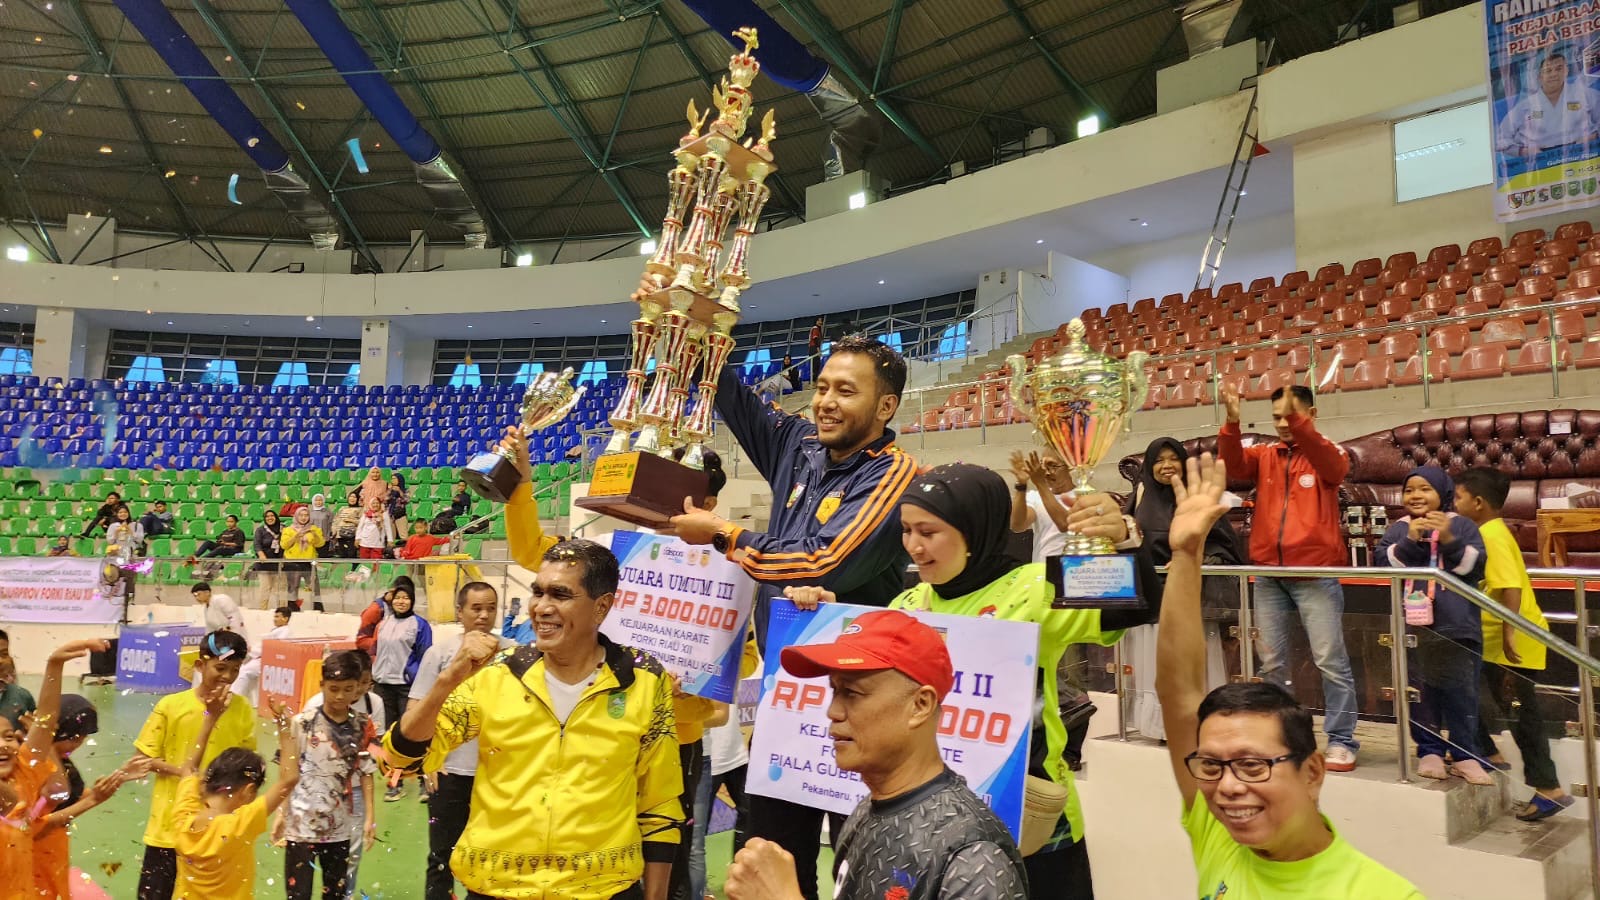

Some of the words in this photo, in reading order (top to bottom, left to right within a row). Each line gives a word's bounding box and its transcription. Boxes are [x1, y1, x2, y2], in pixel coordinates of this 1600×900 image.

[1509, 31, 1557, 54] PIALA
[619, 566, 664, 588] JUARA
[668, 574, 713, 596] UMUM
[716, 582, 736, 600] III
[639, 593, 739, 630] 3.000.000
[620, 617, 673, 637] KEJUARAAN
[673, 628, 710, 645] KARATE
[631, 632, 658, 647] FORKI
[659, 639, 680, 652] RIAU
[677, 656, 699, 670] RIAU
[771, 680, 827, 711] RP
[972, 673, 994, 698] II
[770, 753, 812, 772] PIALA
[802, 782, 851, 802] Pekanbaru,
